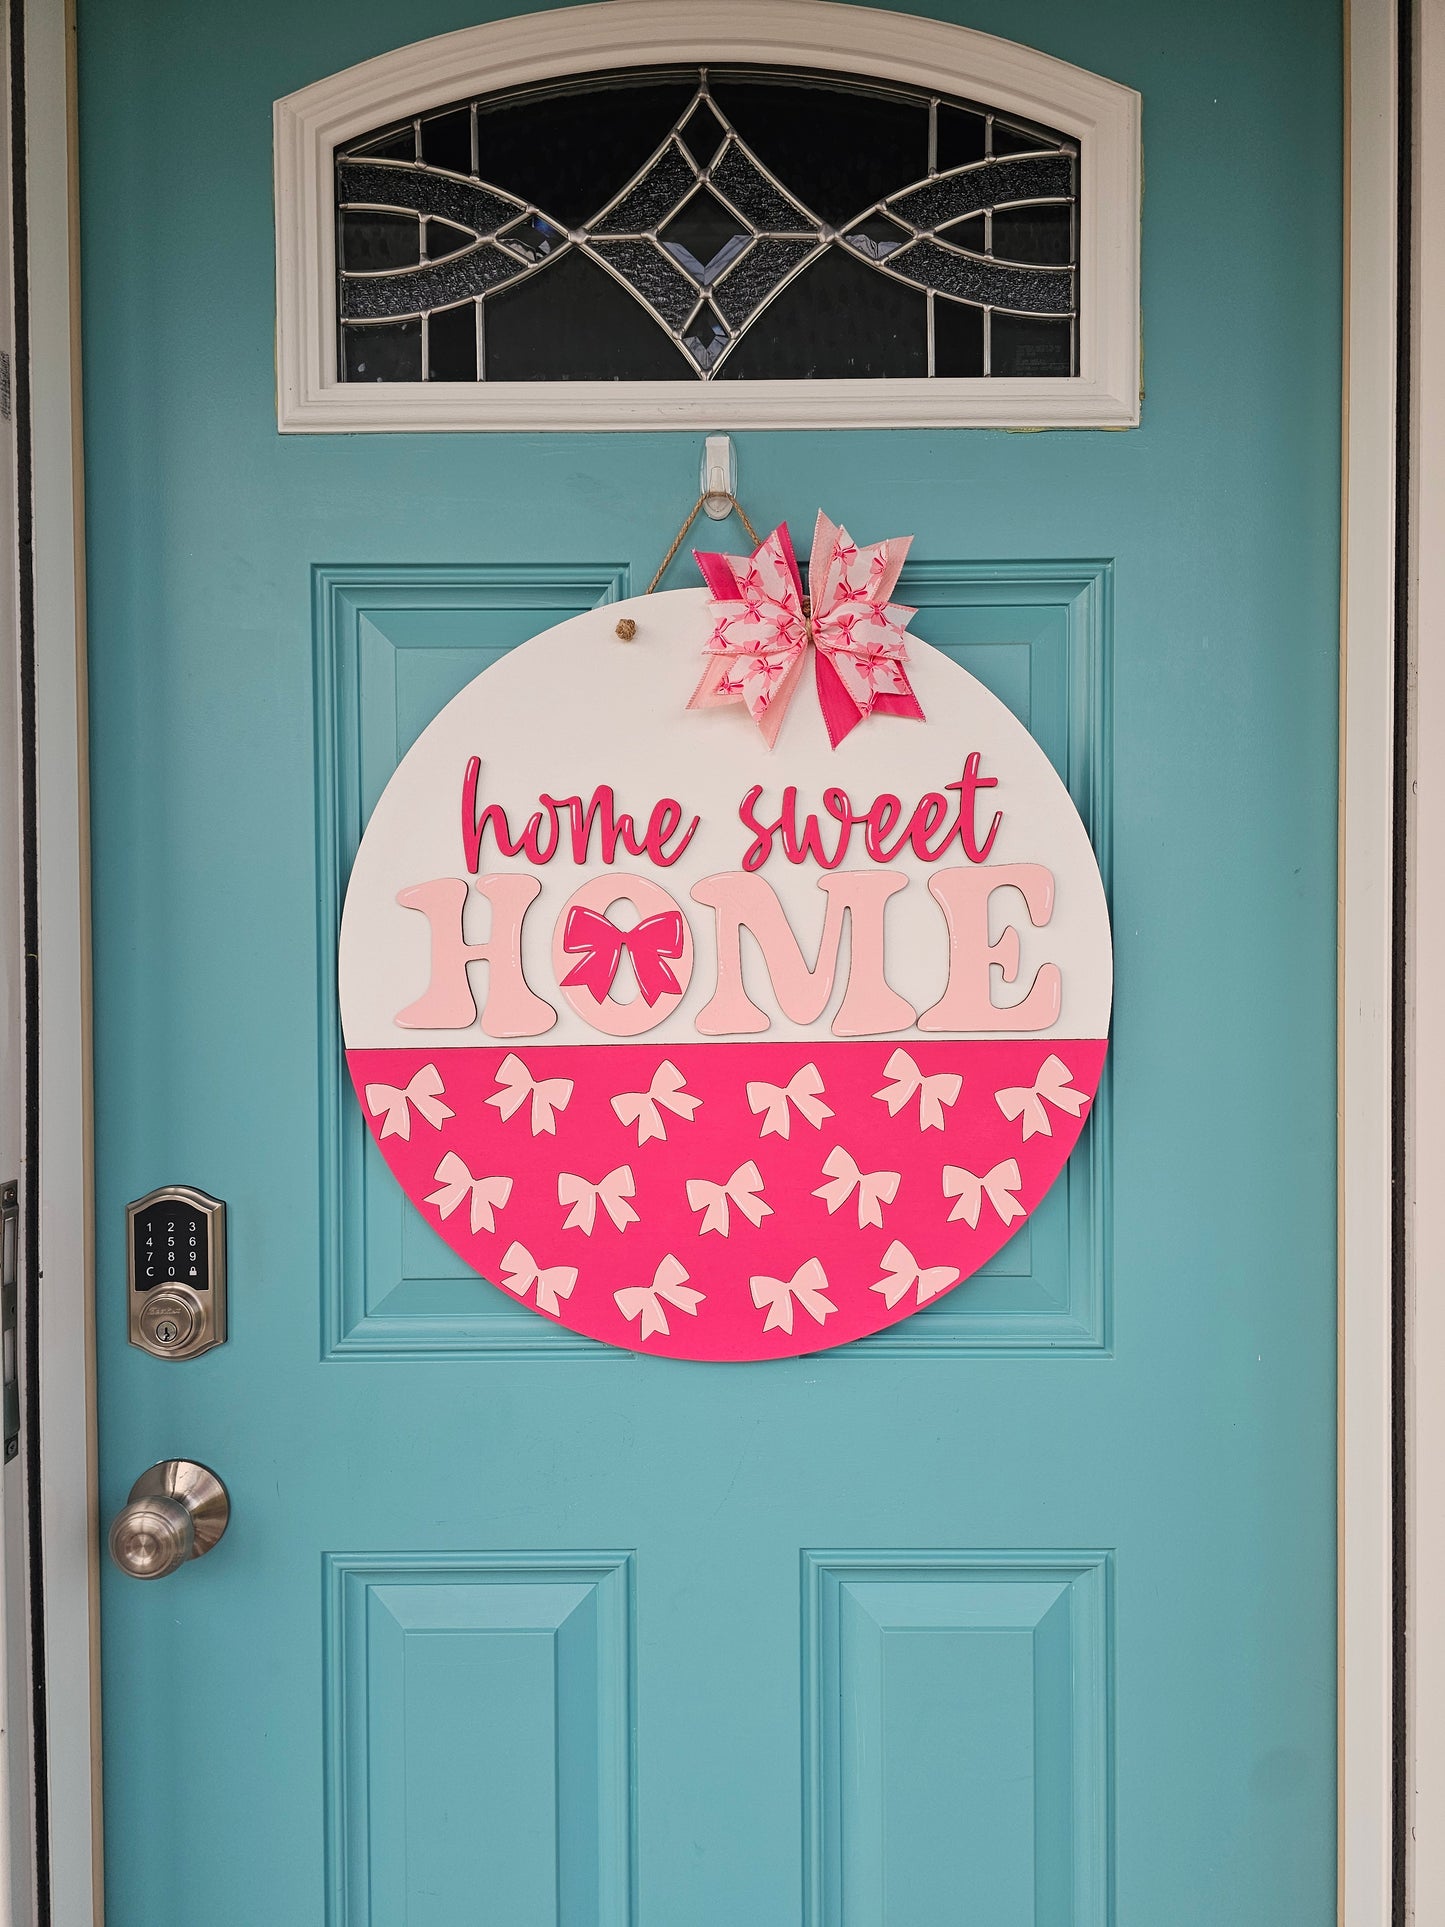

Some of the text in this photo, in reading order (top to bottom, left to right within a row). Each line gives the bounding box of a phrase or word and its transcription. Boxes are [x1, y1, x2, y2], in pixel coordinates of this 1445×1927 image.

[462, 752, 1003, 874] home sweet
[394, 863, 1062, 1039] HOME
[146, 1222, 196, 1232] 1 2 3
[146, 1237, 197, 1247] 4 5 6
[146, 1252, 197, 1262] 7 8 9
[146, 1267, 175, 1277] C 0
